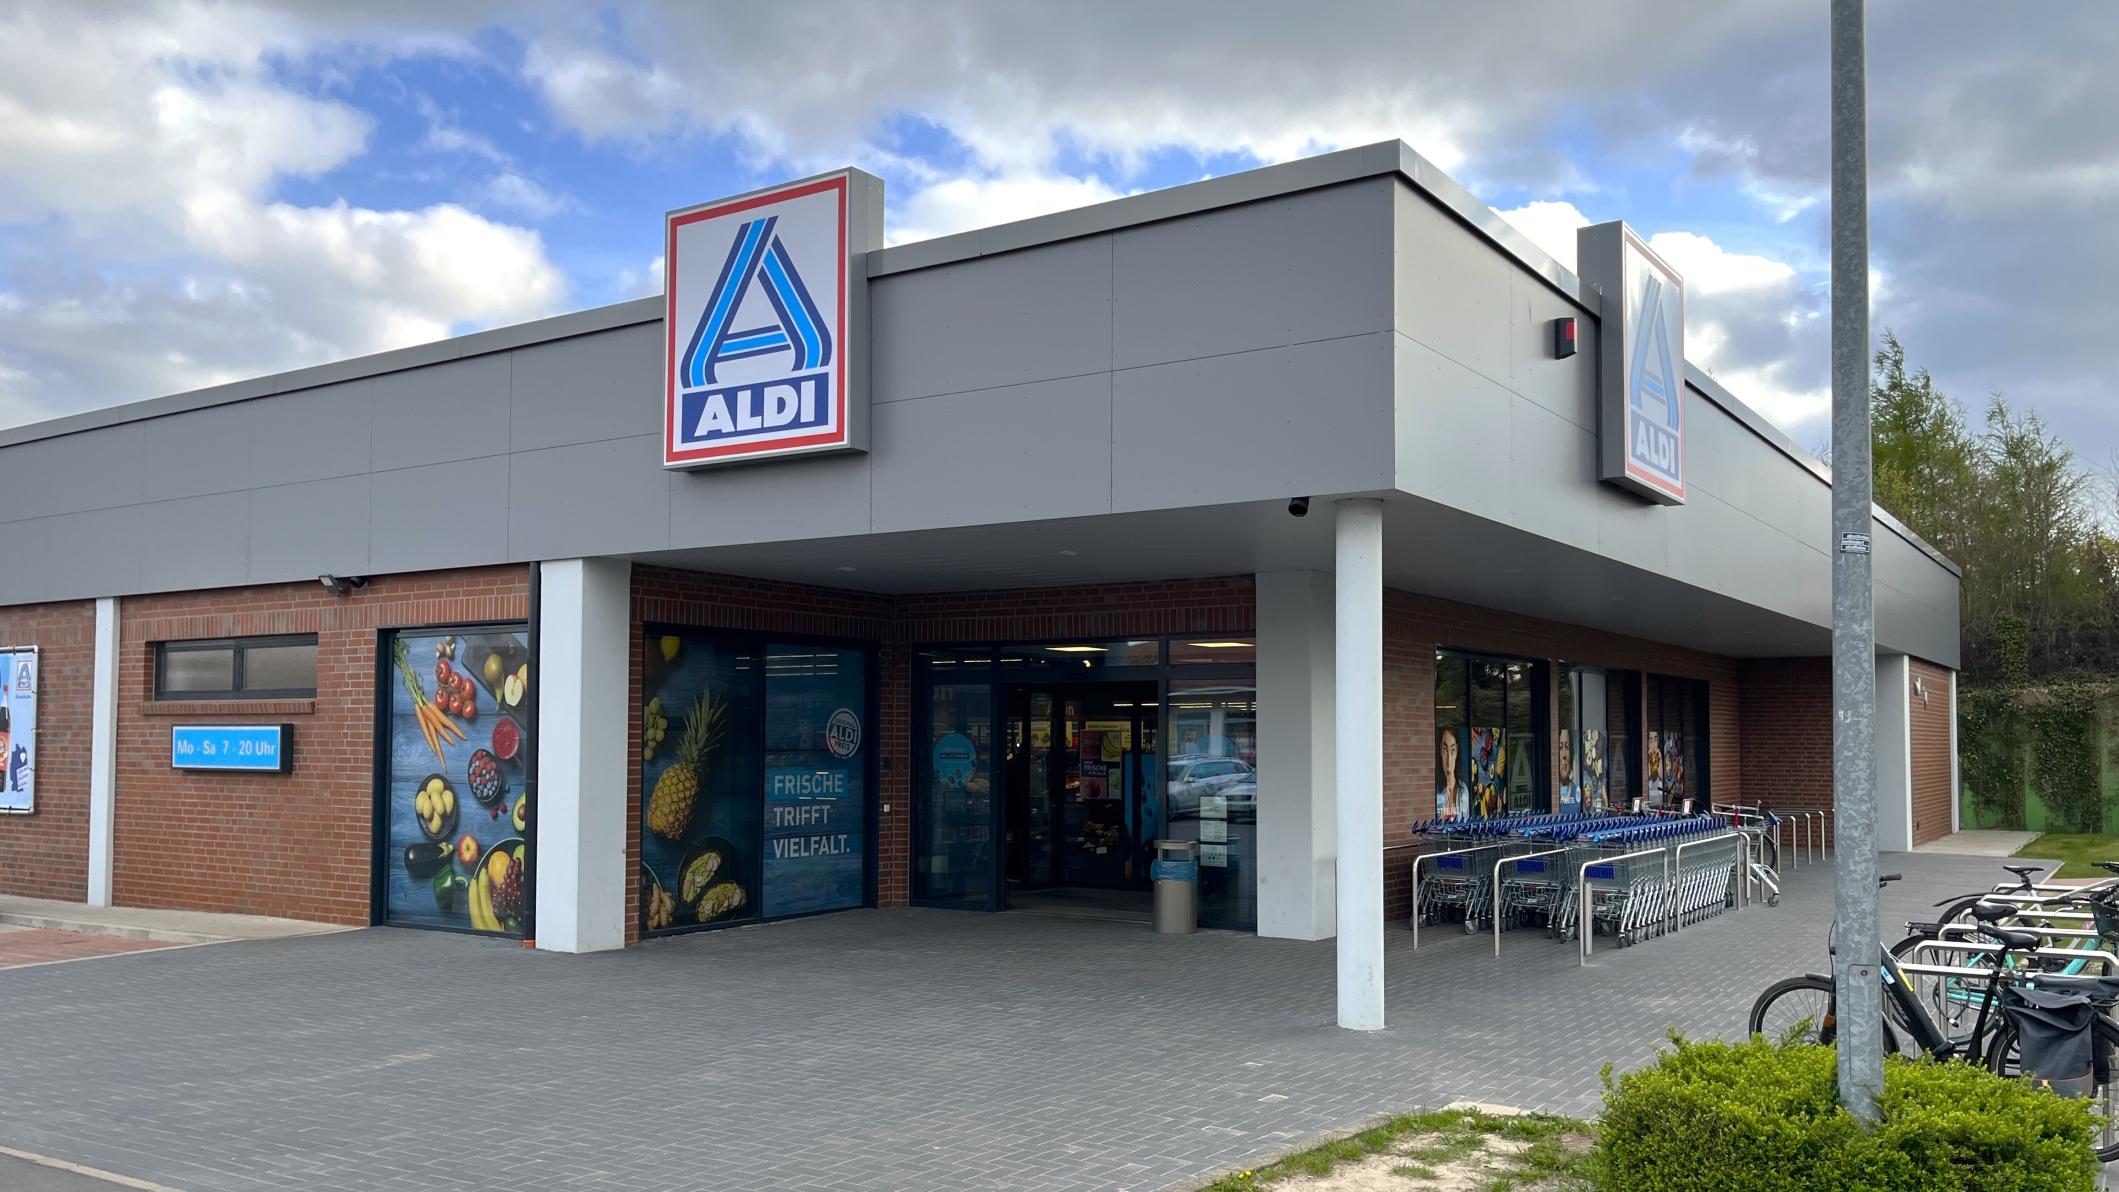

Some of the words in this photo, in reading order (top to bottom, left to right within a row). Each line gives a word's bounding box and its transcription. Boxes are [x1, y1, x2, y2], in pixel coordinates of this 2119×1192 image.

[693, 380, 815, 437] ALDI
[1636, 420, 1676, 474] ALDI
[830, 725, 858, 744] ALDI
[177, 740, 193, 754] Mo
[203, 740, 216, 755] Sa
[222, 740, 229, 755] 7
[239, 740, 252, 755] 20
[255, 741, 275, 755] Uhr
[774, 774, 844, 795] FRISCHE
[773, 805, 831, 828] TRIFFT
[773, 834, 850, 859] VIELFALT.
